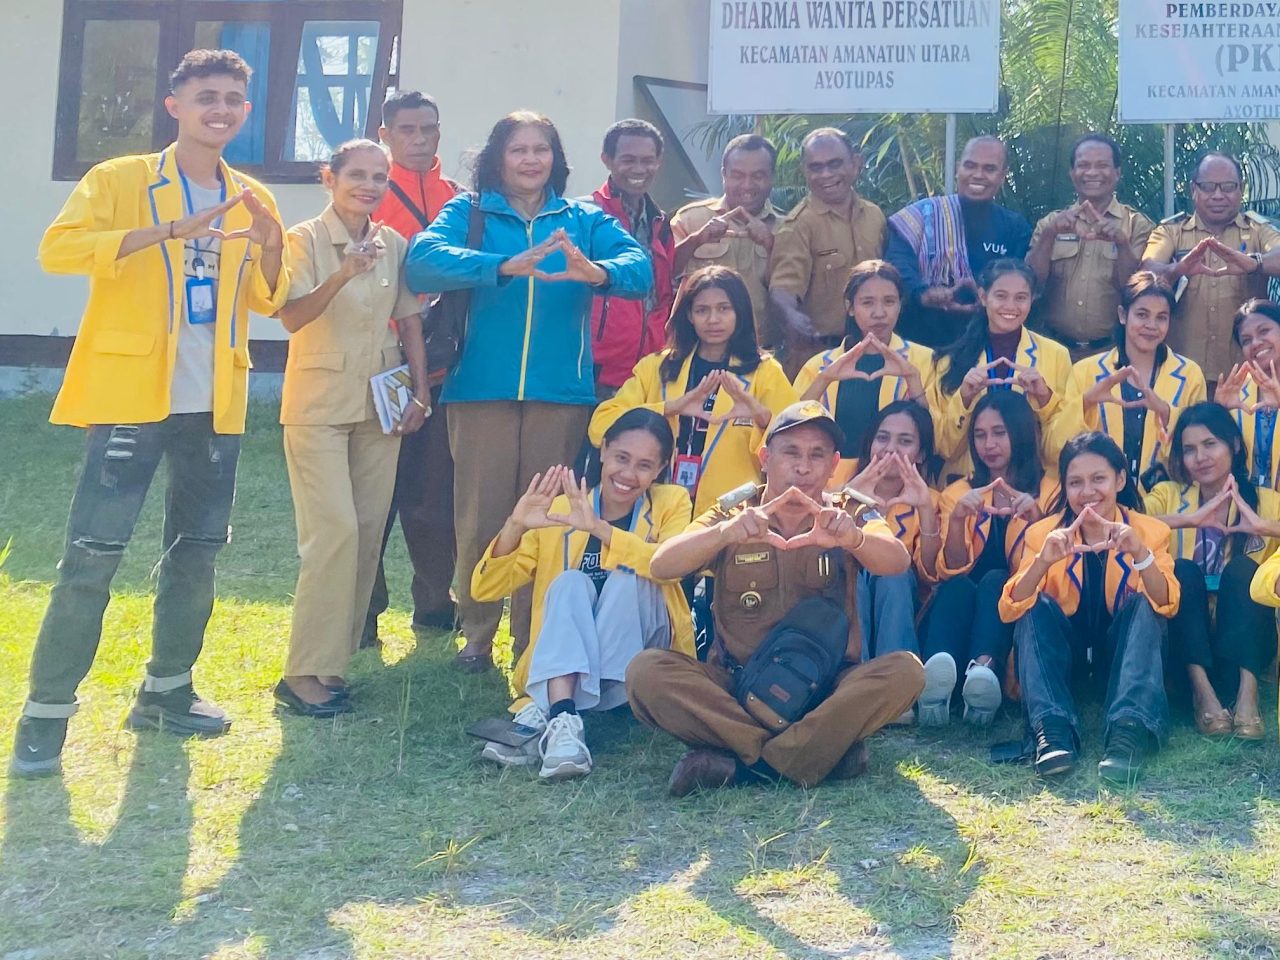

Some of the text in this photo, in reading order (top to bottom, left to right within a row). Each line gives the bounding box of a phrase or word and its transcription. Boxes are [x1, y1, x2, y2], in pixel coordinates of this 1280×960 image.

[721, 0, 992, 30] DHARMA WANITA PERSATUAN
[739, 44, 971, 64] KECAMATAN AMANATUN UTARA
[814, 70, 895, 89] AYOTUPAS
[1147, 85, 1237, 99] KECAMATAN
